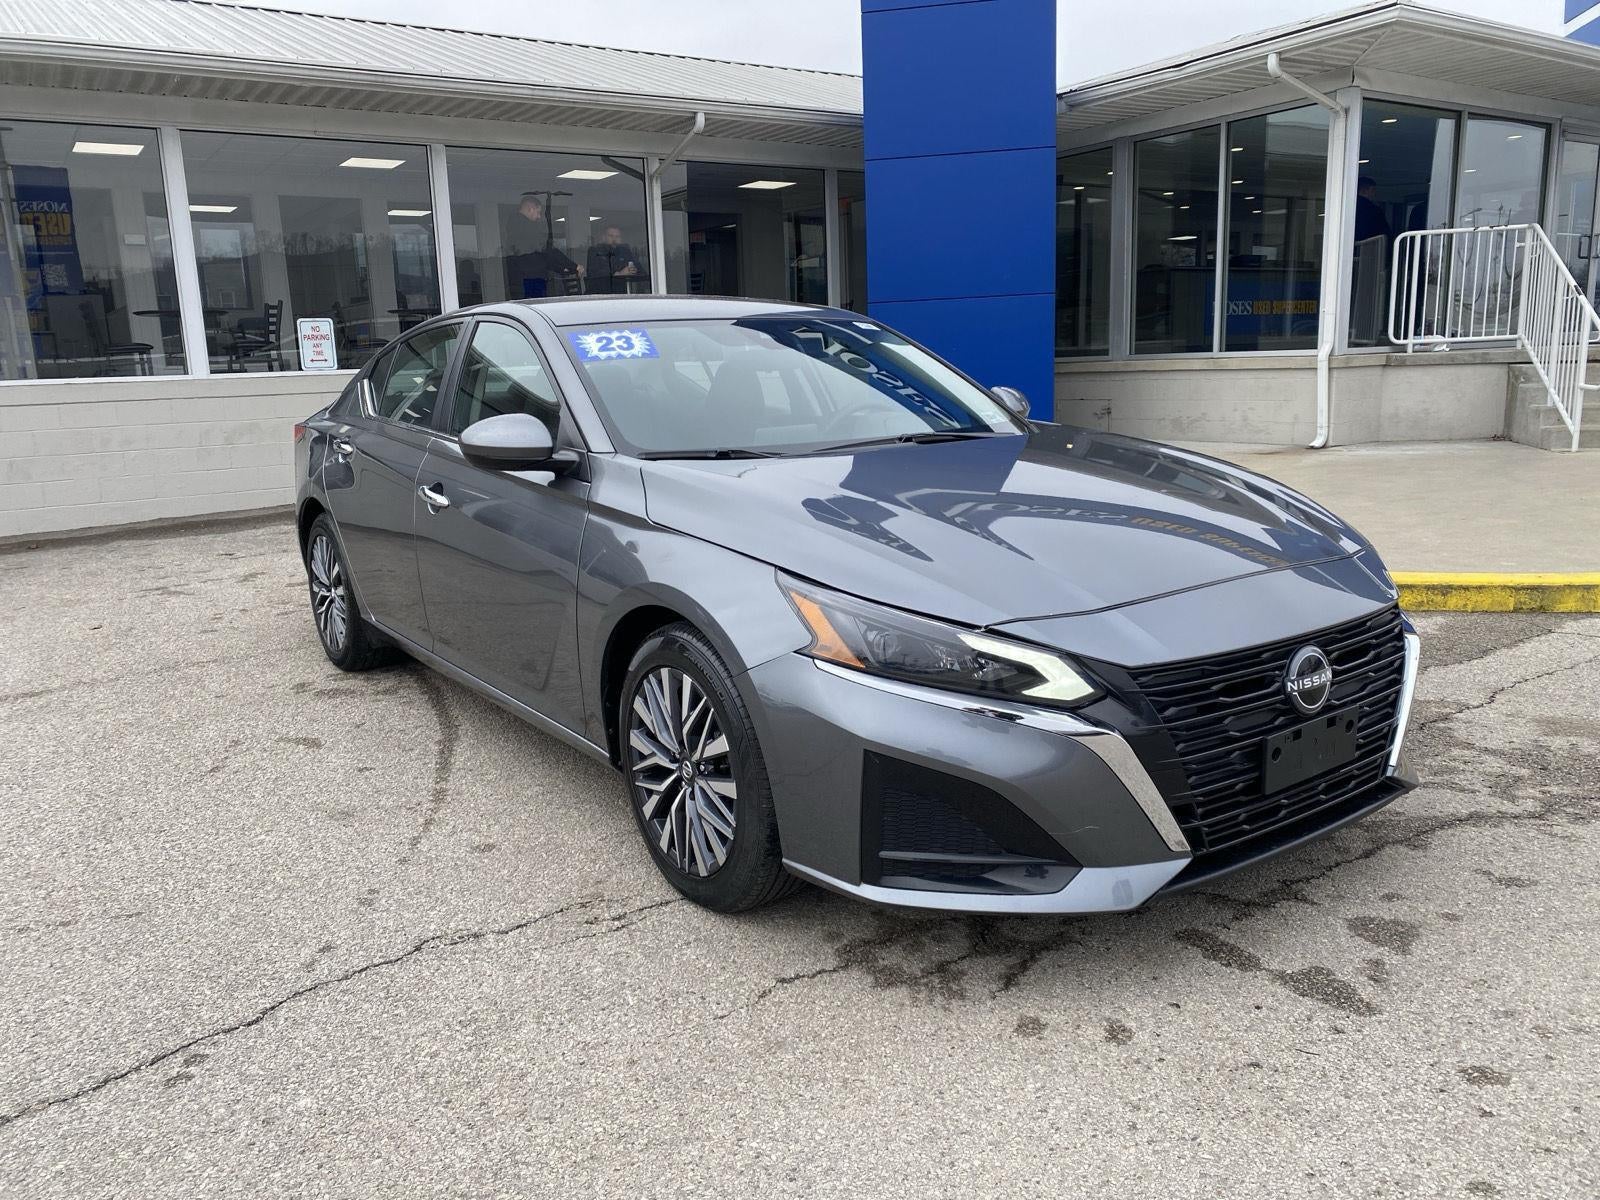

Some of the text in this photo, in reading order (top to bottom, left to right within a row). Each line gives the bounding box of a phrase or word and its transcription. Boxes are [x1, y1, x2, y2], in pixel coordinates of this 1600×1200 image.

[310, 325, 320, 333] NO
[303, 333, 330, 341] PARKING
[595, 335, 635, 352] 23
[1287, 667, 1333, 692] NISSAN
